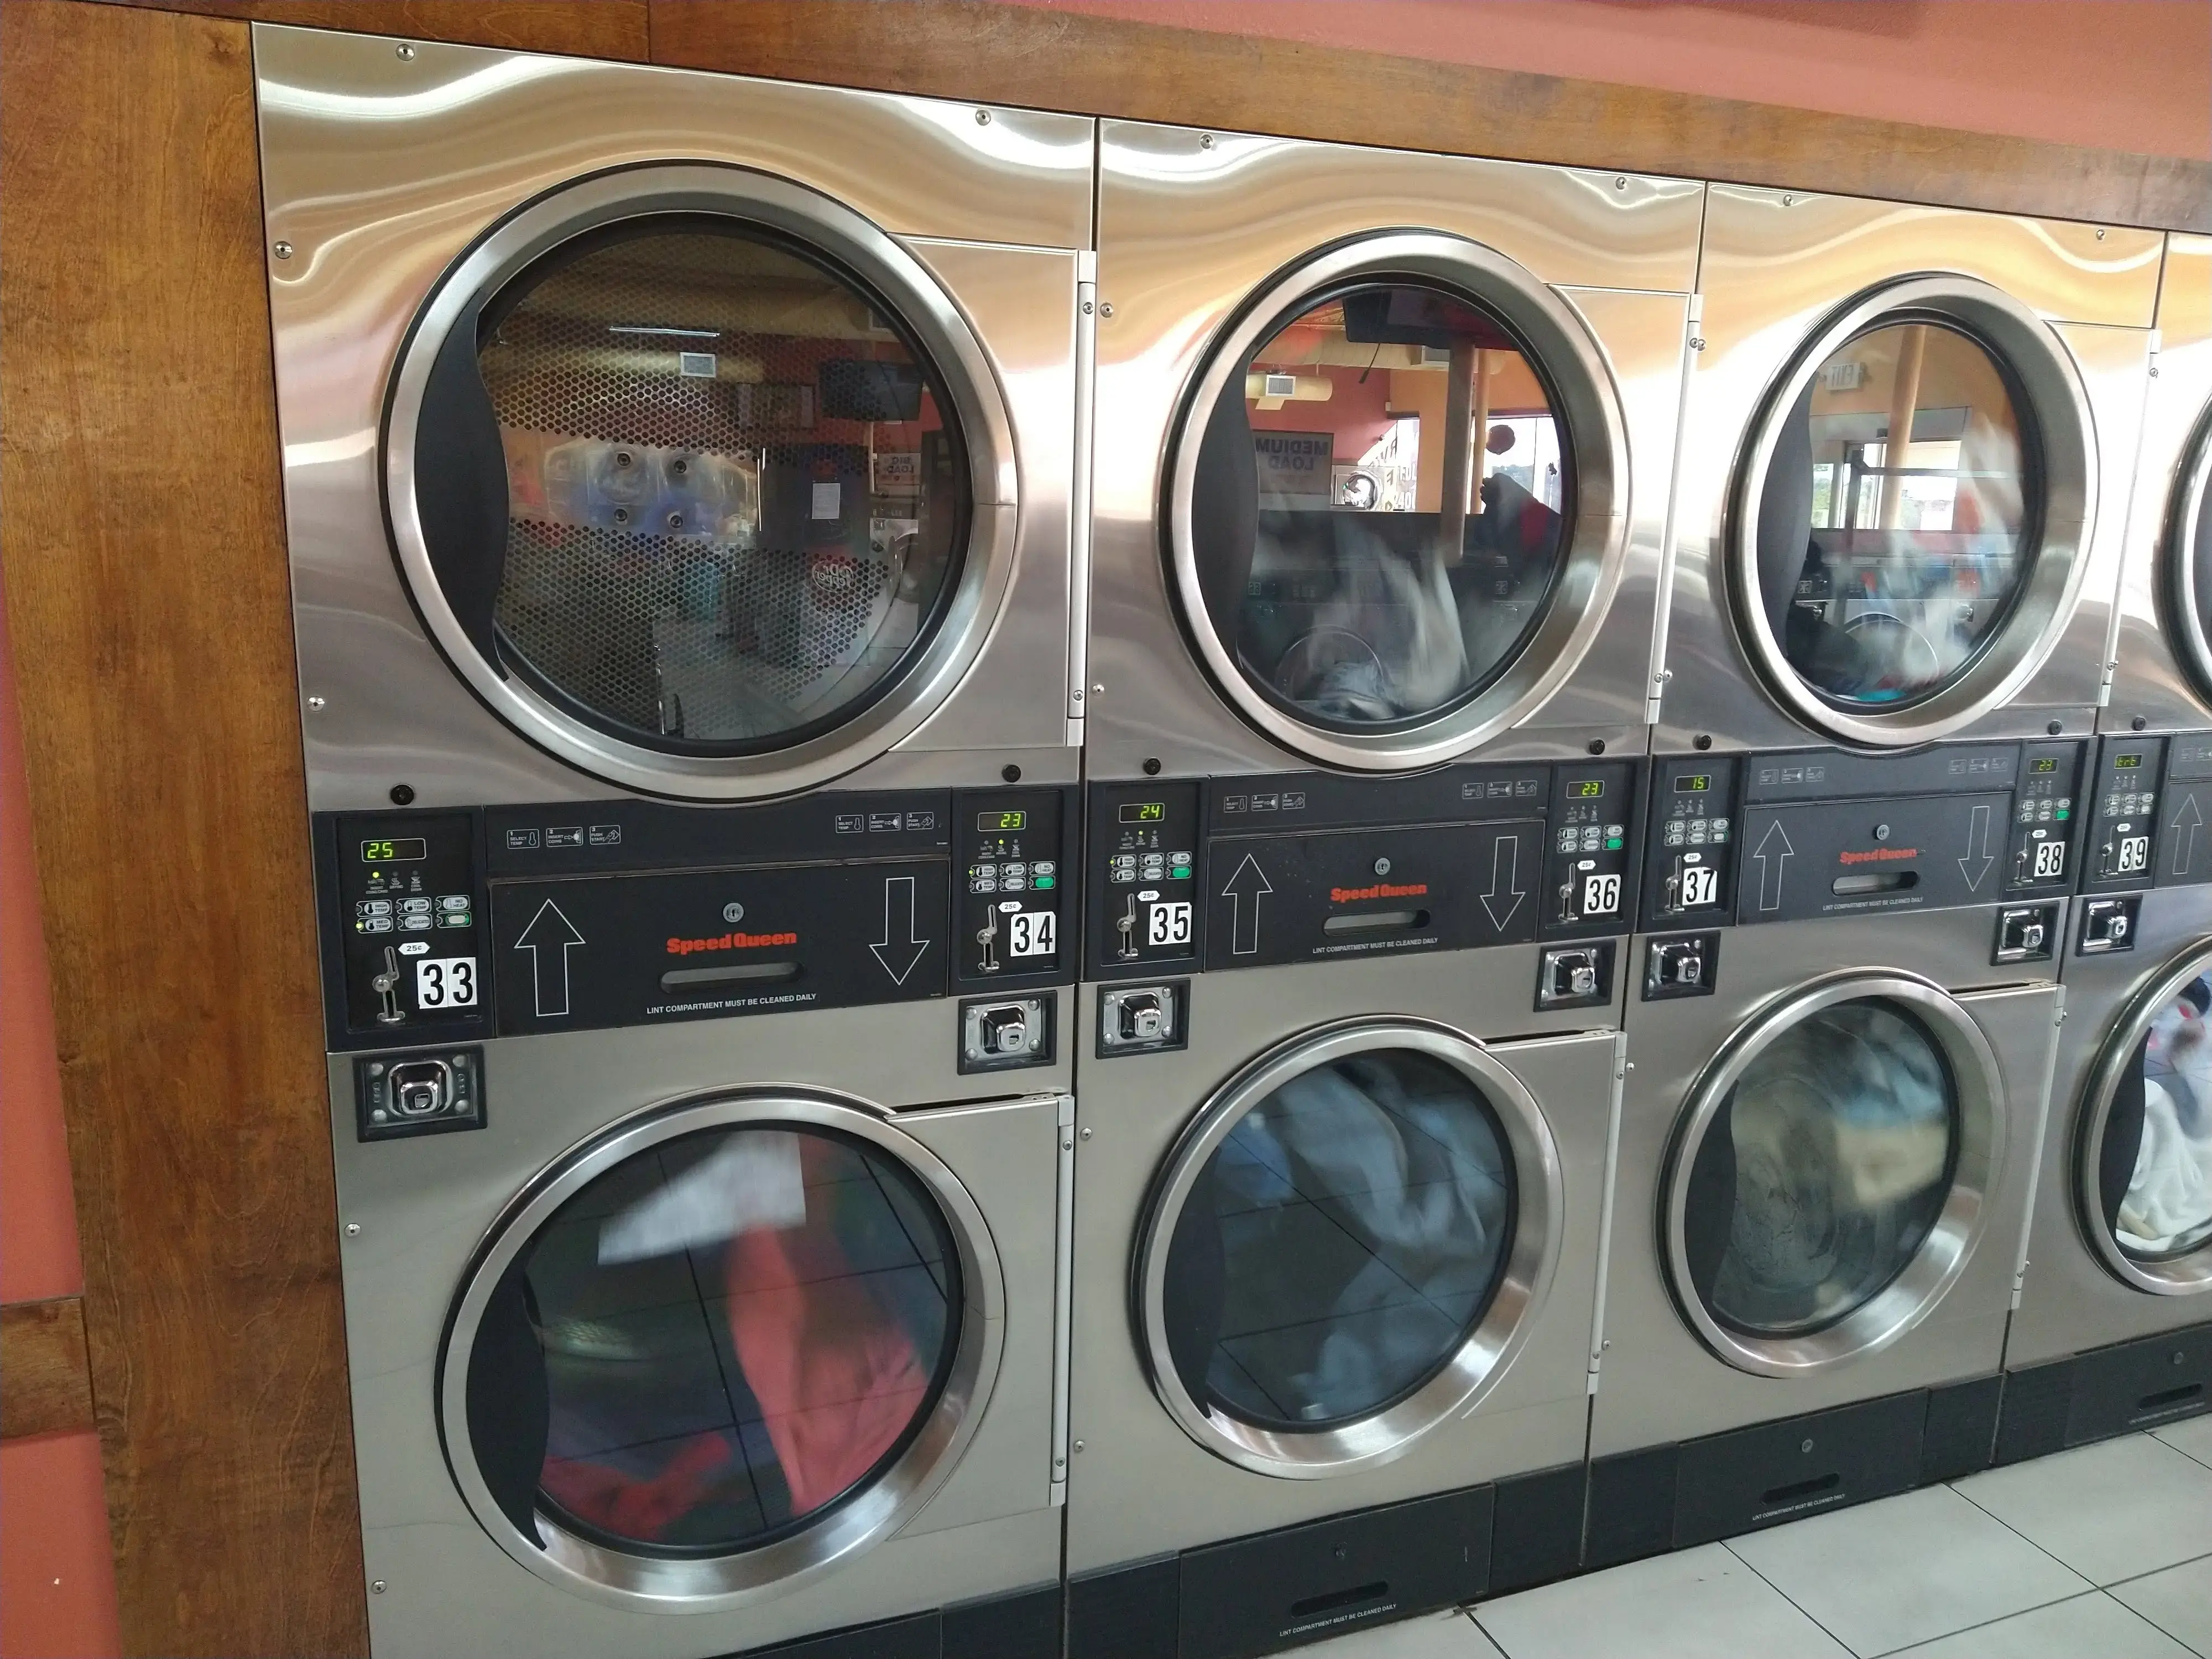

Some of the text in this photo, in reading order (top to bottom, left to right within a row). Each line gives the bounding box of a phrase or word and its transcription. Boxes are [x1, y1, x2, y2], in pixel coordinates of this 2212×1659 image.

[2039, 760, 2053, 771] 23
[1582, 782, 1599, 796] 23
[1693, 777, 1704, 789] 15
[1000, 813, 1021, 827] 23
[1140, 805, 1160, 819] 24
[367, 842, 393, 858] 25
[1840, 849, 1879, 865] Speed
[2038, 844, 2062, 874] 38
[2122, 838, 2146, 869] 39
[1330, 884, 1427, 903] Speed Queen
[1588, 878, 1617, 911] 36
[1686, 869, 1714, 902] 37
[1154, 905, 1188, 942] 35
[667, 932, 797, 955] Speed Queen
[1014, 915, 1053, 953] 34
[1326, 943, 1369, 953] COMPARTMENT
[423, 962, 473, 1005] 33
[666, 1001, 723, 1013] COMPARTMENT
[760, 995, 794, 1004] CLEANED
[1292, 1619, 1333, 1633] COMPARTMENT
[1357, 1608, 1381, 1618] CLEANED
